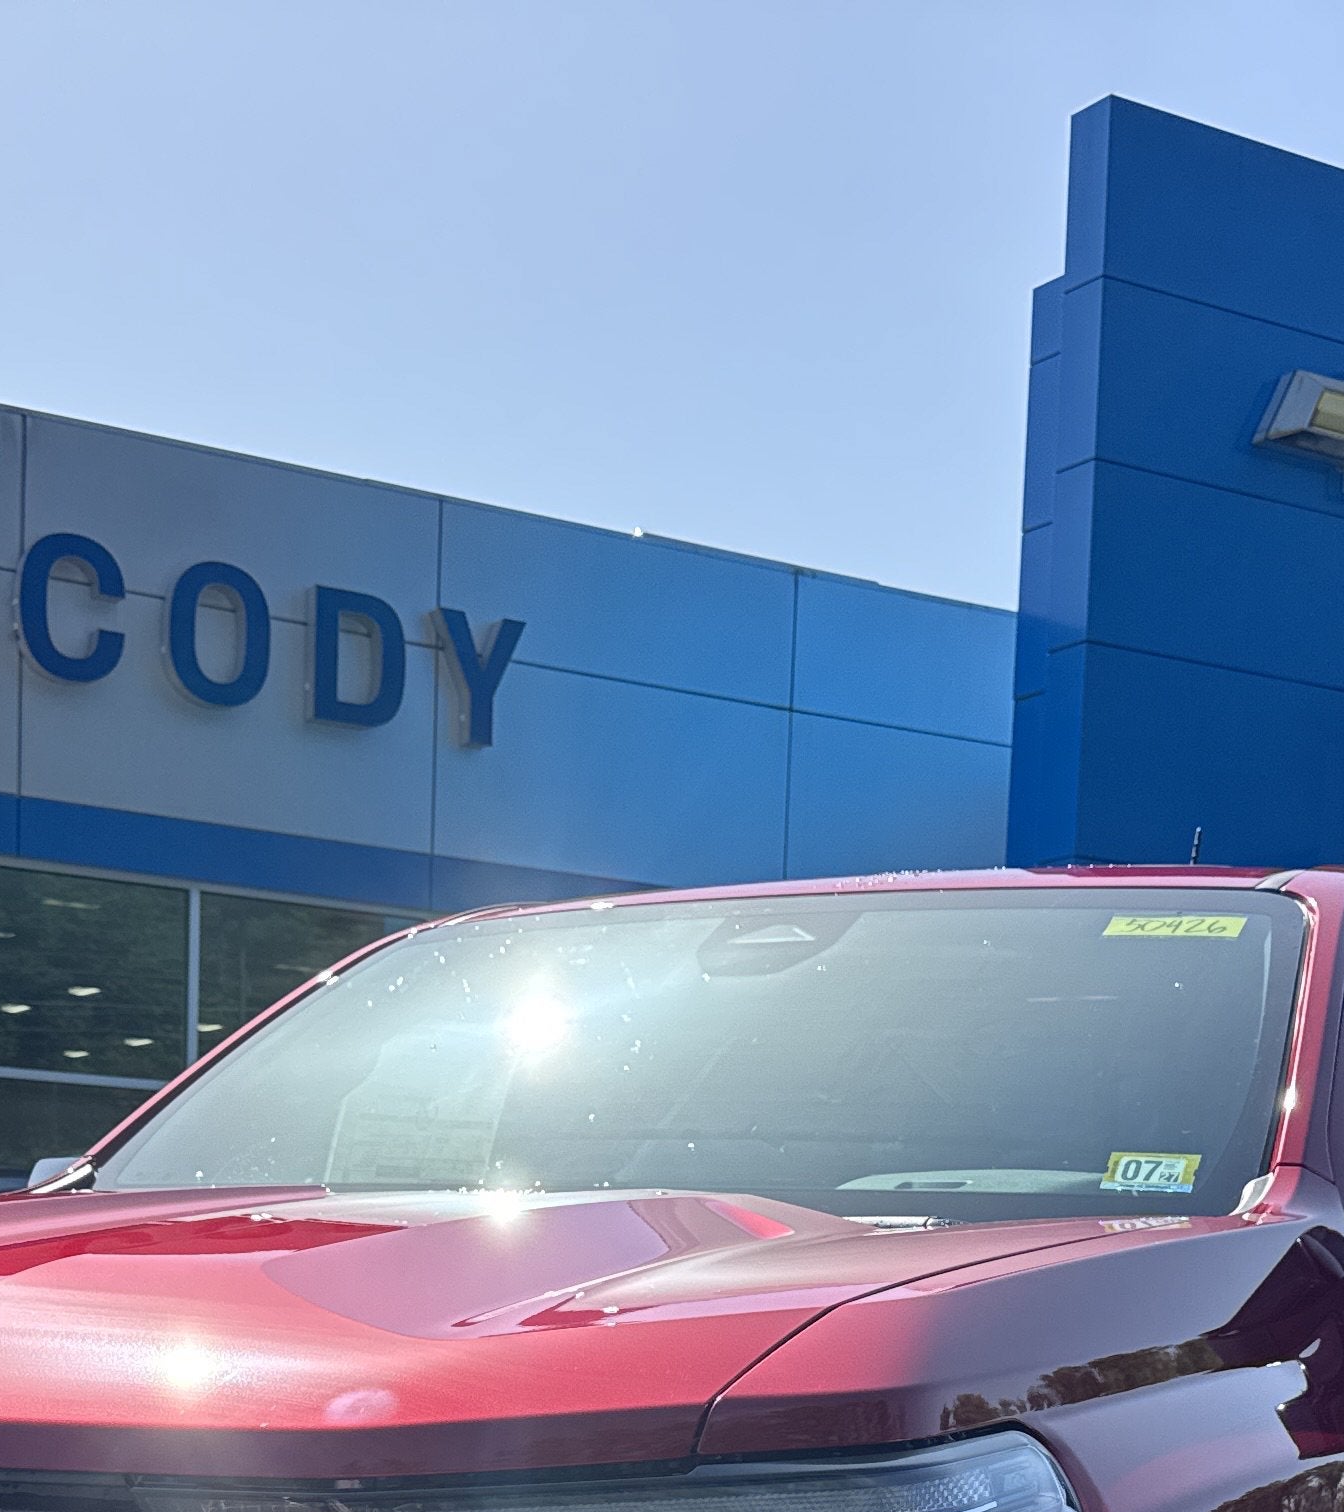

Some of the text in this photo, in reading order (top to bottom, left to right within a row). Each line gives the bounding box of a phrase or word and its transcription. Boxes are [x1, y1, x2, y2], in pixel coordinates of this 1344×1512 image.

[16, 532, 526, 747] CODY
[1121, 1159, 1163, 1182] 07
[1159, 1171, 1181, 1183] 27
